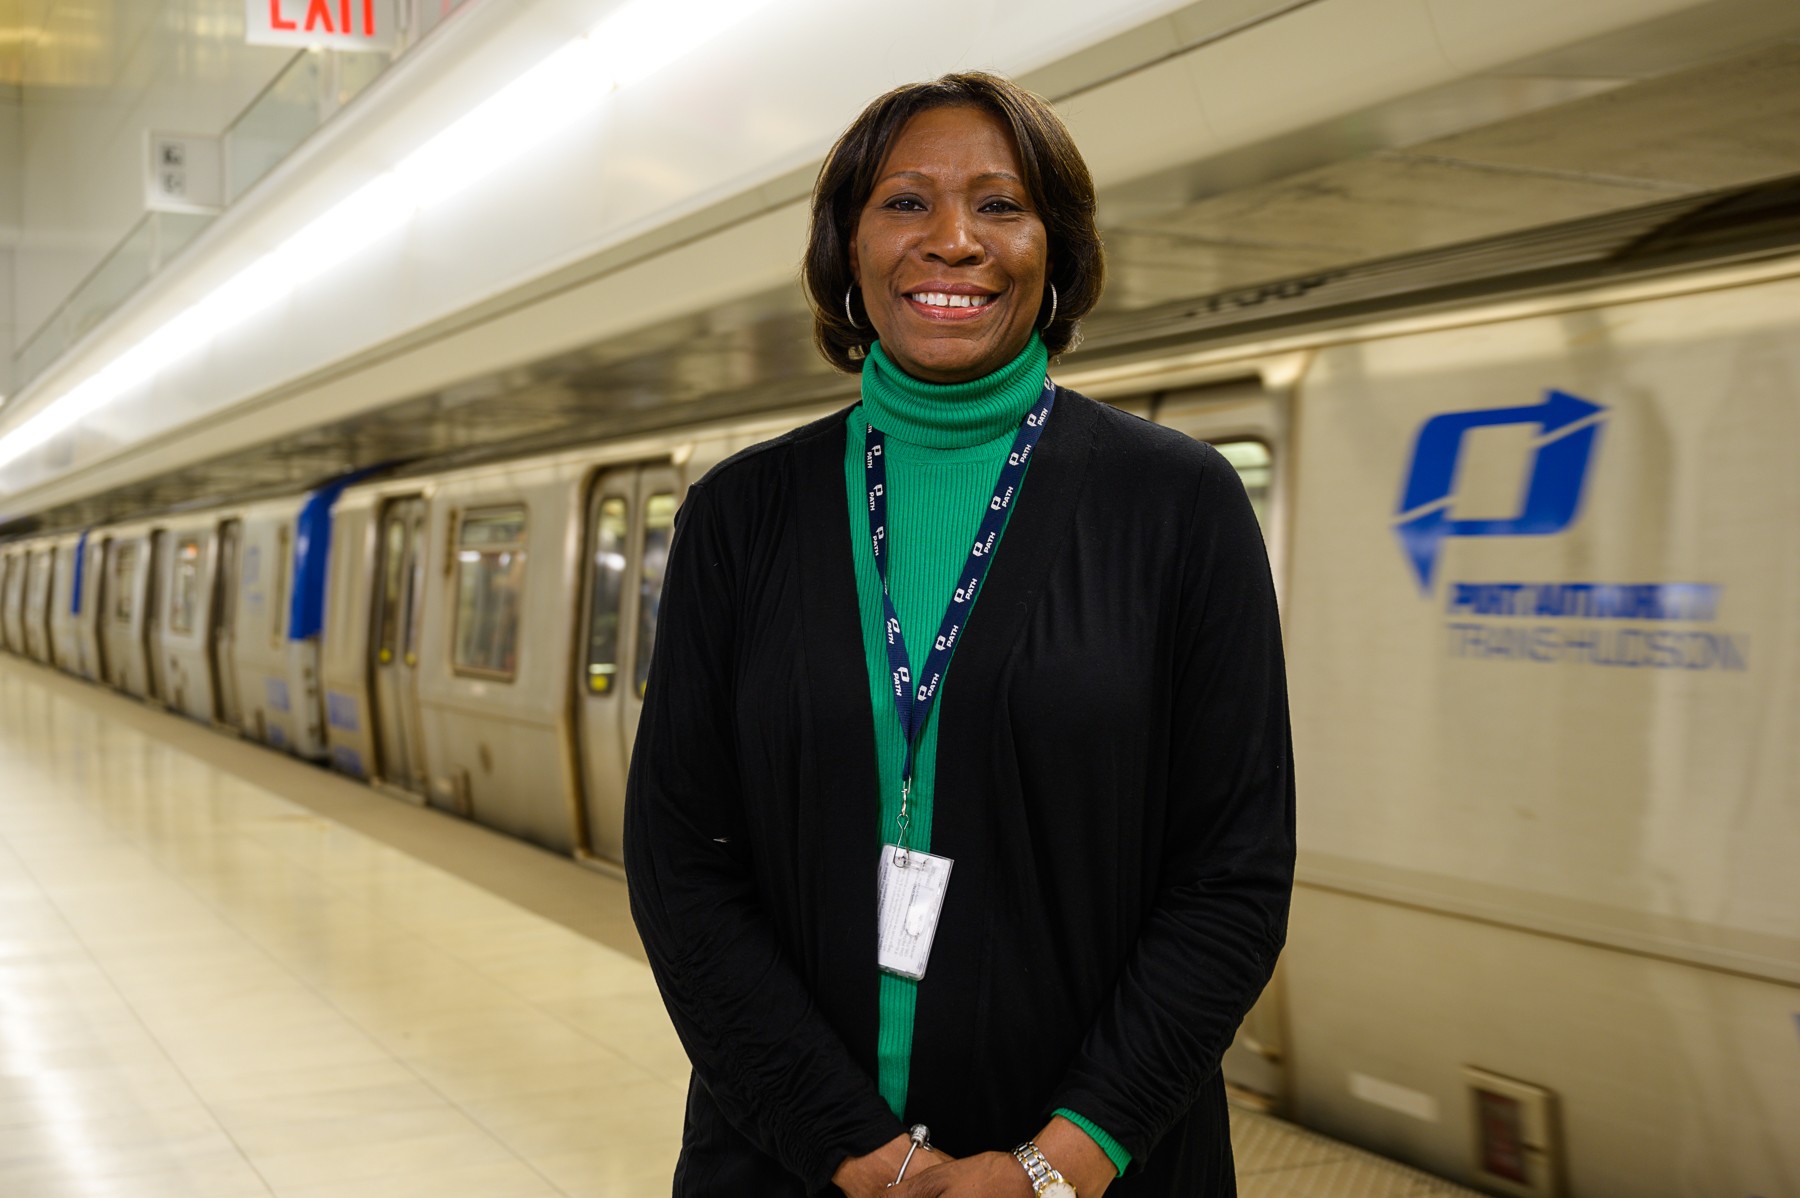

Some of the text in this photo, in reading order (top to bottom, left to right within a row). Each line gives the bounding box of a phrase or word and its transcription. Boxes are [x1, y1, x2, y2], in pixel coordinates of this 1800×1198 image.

[1037, 408, 1048, 426] PATH
[1020, 444, 1032, 464] PATH
[1002, 486, 1014, 508] PATH
[983, 531, 996, 554] PATH
[965, 578, 978, 600] PATH
[886, 621, 894, 644] PATH
[947, 624, 959, 648] PATH
[893, 672, 902, 696] PATH
[927, 673, 940, 697] PATH
